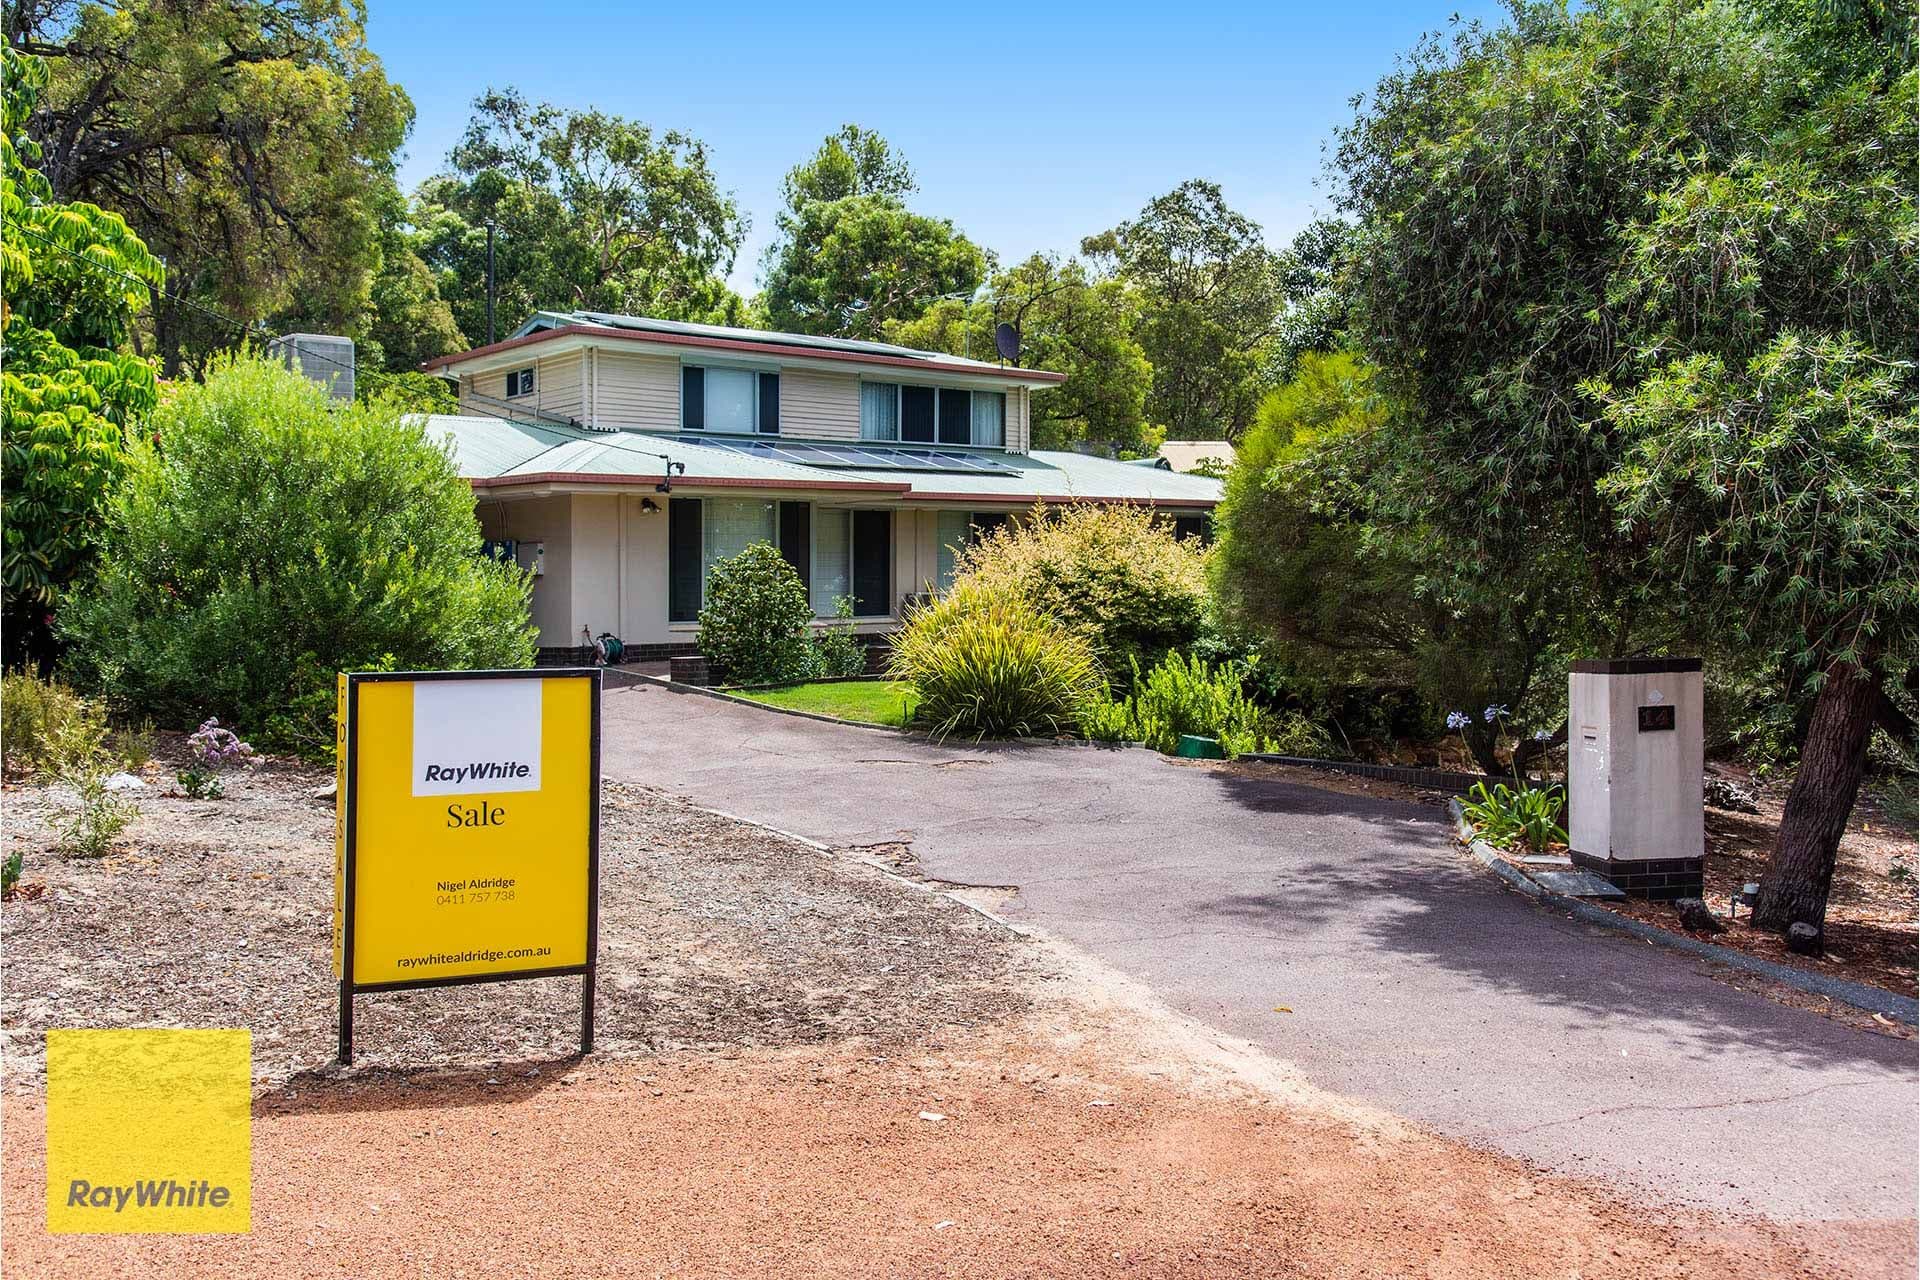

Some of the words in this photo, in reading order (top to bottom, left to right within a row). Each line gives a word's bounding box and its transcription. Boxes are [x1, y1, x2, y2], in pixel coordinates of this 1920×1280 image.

[447, 800, 505, 828] Sale
[437, 880, 466, 892] Nigel
[469, 878, 516, 889] Aldridge
[436, 894, 465, 905] 0411
[470, 893, 490, 903] 757
[495, 891, 515, 901] 738
[397, 947, 551, 968] raywhitealdridge.com.au
